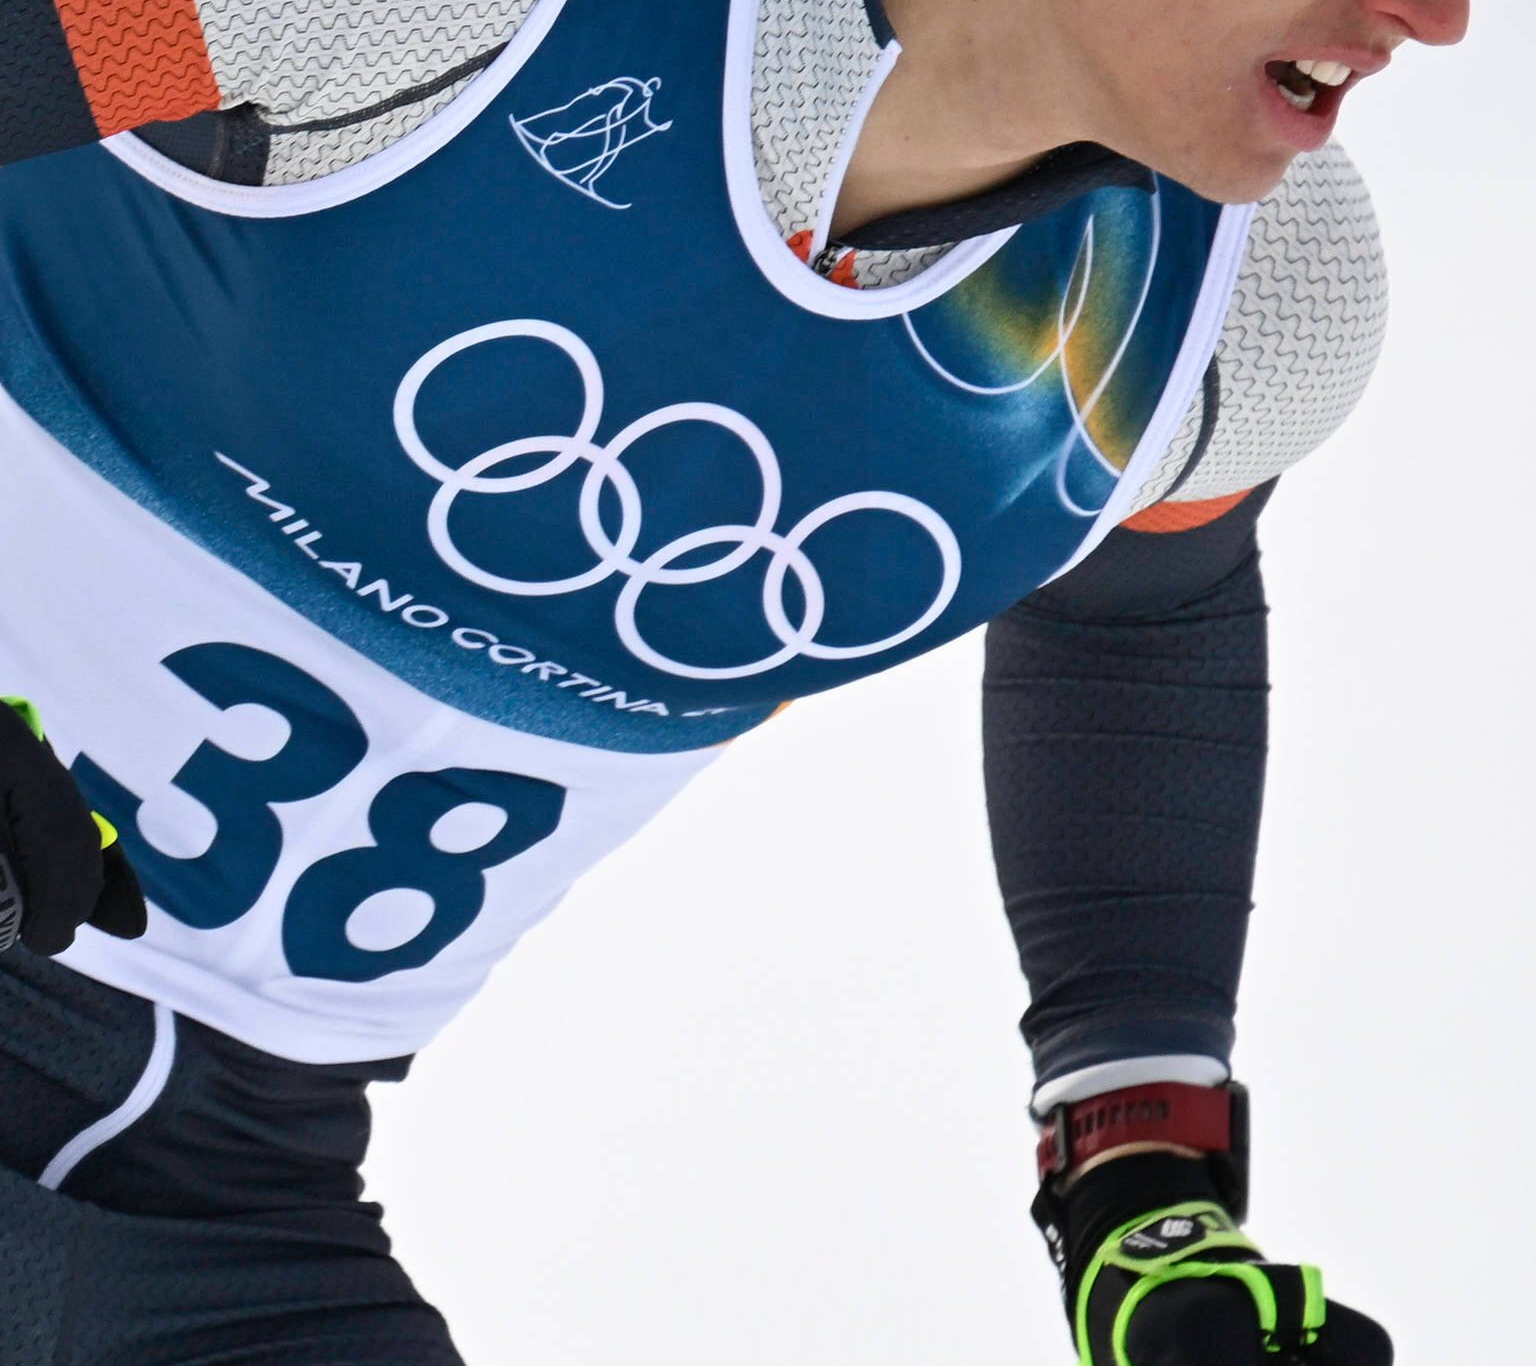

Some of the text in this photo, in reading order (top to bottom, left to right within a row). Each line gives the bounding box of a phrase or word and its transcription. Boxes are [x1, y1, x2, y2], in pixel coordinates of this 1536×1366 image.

[214, 451, 669, 717] MILANO CORTINA
[69, 641, 566, 983] 38
